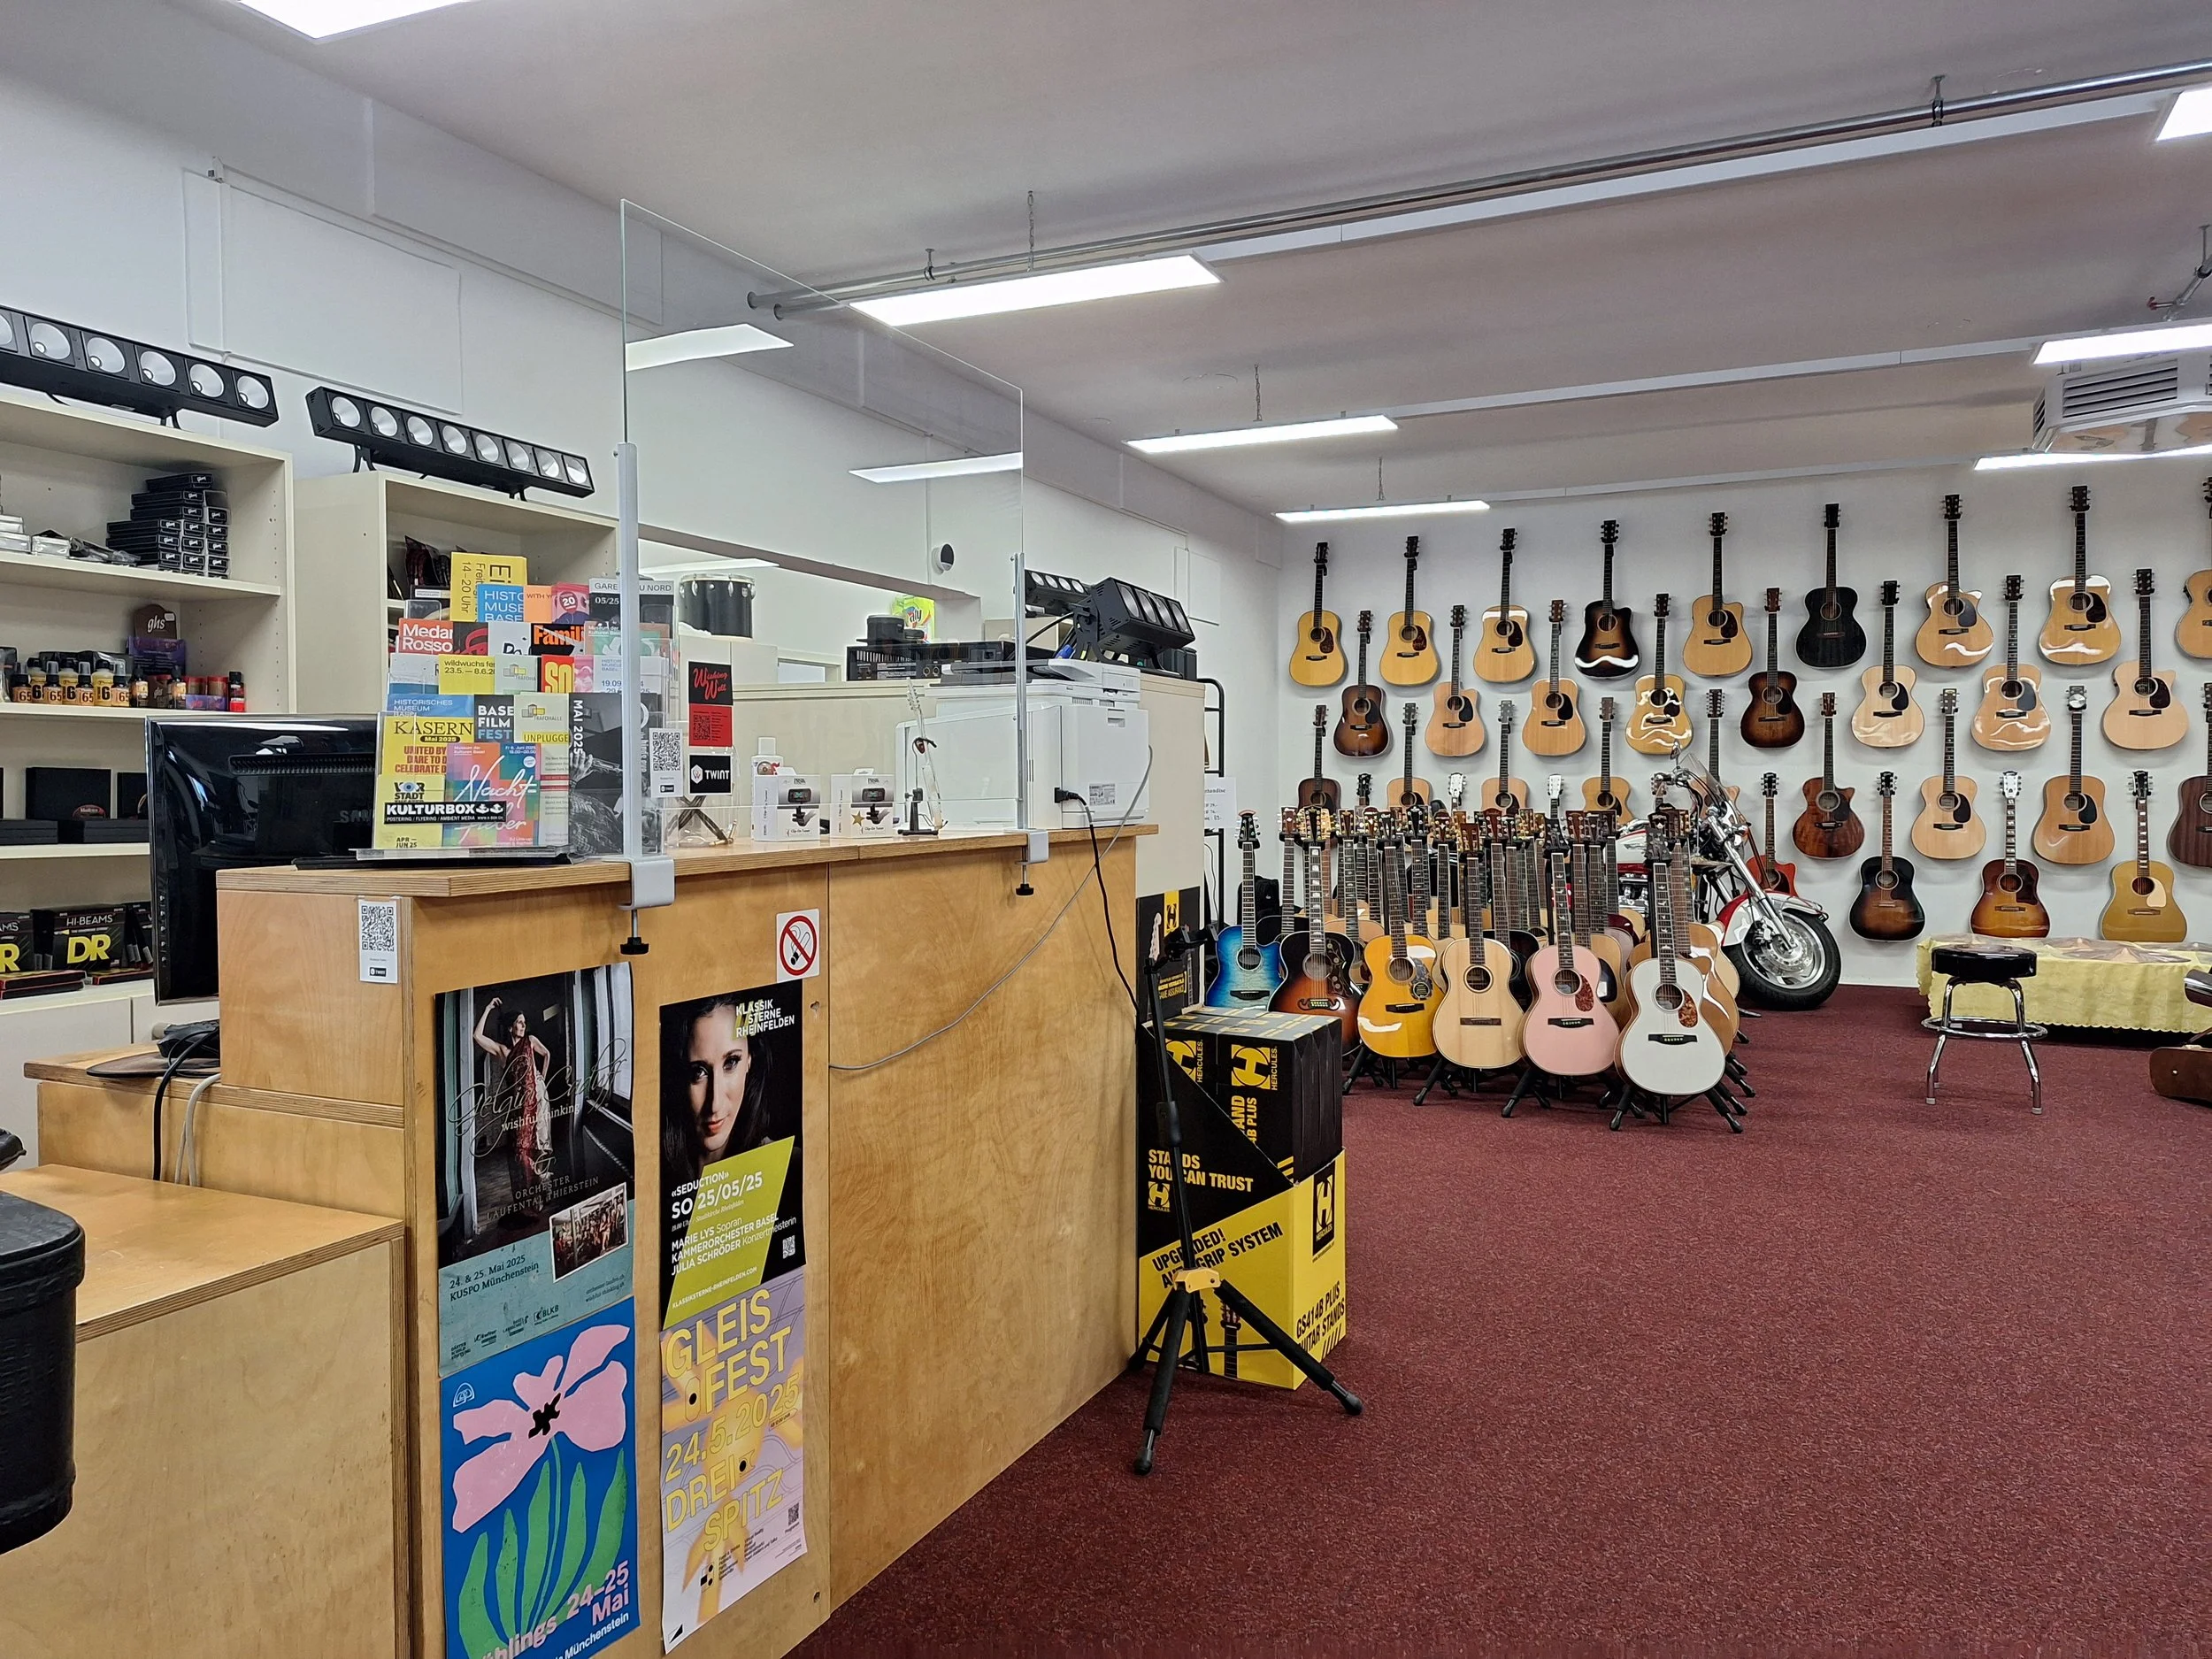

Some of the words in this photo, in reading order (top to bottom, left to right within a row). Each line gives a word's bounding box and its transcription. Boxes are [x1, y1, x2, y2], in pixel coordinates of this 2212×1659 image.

[461, 595, 472, 614] Uhr
[562, 596, 576, 607] 20
[595, 596, 619, 605] 05/25
[147, 615, 165, 633] ghs
[403, 637, 453, 653] Rosso
[704, 680, 727, 701] Well
[478, 718, 511, 728] FILM
[573, 700, 583, 722] MAI
[478, 729, 512, 740] FEST
[524, 733, 569, 742] UNPLUGGE
[573, 726, 583, 754] 2025
[395, 764, 440, 773] CELEBRATE
[704, 770, 730, 780] TWINT
[387, 803, 475, 815] KULTURBOX
[66, 914, 114, 926] HI-BEAMS
[0, 942, 20, 972] R
[66, 933, 111, 964] DR
[735, 998, 774, 1017] KLASSIK
[748, 1007, 781, 1025] STERNE
[735, 1015, 795, 1039] RHEINFELDEN
[501, 1111, 538, 1133] wishful
[1247, 1097, 1257, 1126] PLUS
[1148, 1149, 1201, 1170] STADS
[515, 1174, 571, 1200] ORCHESTER
[1148, 1164, 1173, 1181] YOU
[1183, 1168, 1206, 1186] AN
[1209, 1172, 1254, 1193] TRUST
[487, 1194, 544, 1221] LAUFENTAL
[671, 1197, 694, 1220] SO
[696, 1171, 764, 1211] 25/05/25
[671, 1233, 699, 1252] MARIE
[699, 1226, 715, 1242] LYS
[716, 1216, 742, 1235] Sopran
[671, 1225, 755, 1264] KAMMERORCHESTER
[756, 1212, 780, 1229] BASEL
[671, 1260, 695, 1277] JULIA
[696, 1239, 741, 1267] SCHRÖDER
[741, 1216, 797, 1248] Konzertmeisterin
[1195, 1247, 1225, 1269] GRIP
[1228, 1221, 1284, 1257] SYSTEM
[1152, 1227, 1226, 1272] UPGRDED!
[449, 1284, 480, 1302] KUSPO
[481, 1262, 540, 1291] Münchenstein
[465, 1274, 472, 1284] &
[488, 1262, 505, 1275] Mai
[506, 1255, 526, 1270] 2025
[672, 1266, 757, 1310] KLASSIKSTERNE-RHEINFELDEN.COM
[541, 1304, 559, 1318] BLKB
[1296, 1297, 1324, 1340] GS414B
[1325, 1280, 1340, 1311] PLUS
[664, 1288, 772, 1379] GLEIS
[1299, 1324, 1320, 1352] UITAR
[1322, 1297, 1345, 1337] STANDS
[704, 1325, 792, 1416] FEST
[664, 1372, 800, 1484] 24.5.2025
[664, 1453, 737, 1534] DREI
[703, 1466, 785, 1553] SPITZ
[566, 1560, 630, 1620] 24–25
[592, 1583, 630, 1626] Mai
[564, 1611, 630, 1659] Münchenstein
